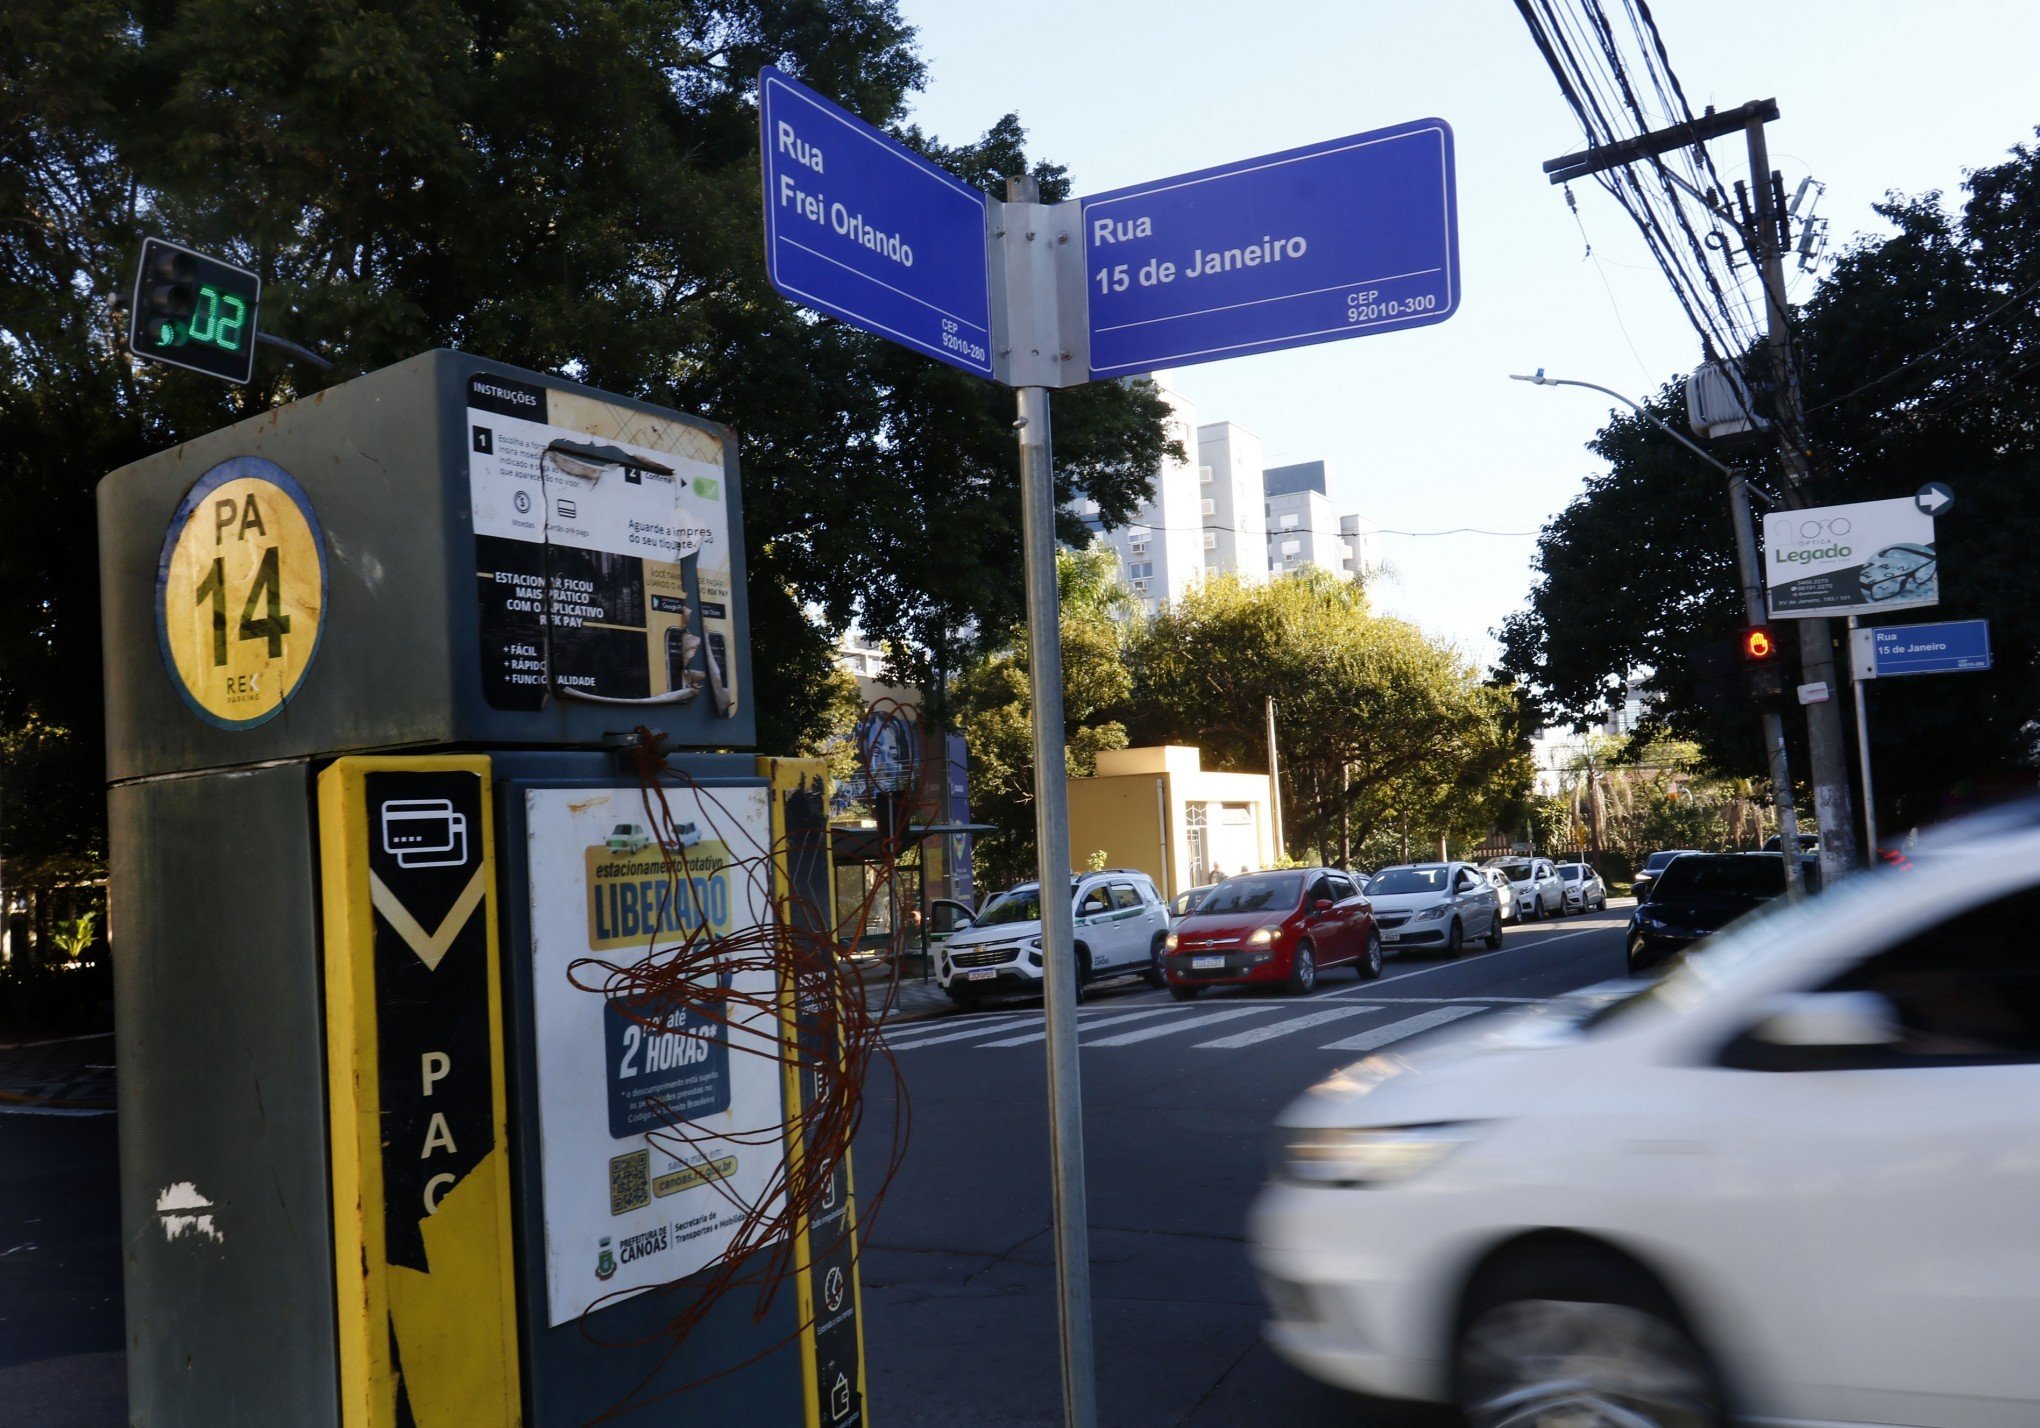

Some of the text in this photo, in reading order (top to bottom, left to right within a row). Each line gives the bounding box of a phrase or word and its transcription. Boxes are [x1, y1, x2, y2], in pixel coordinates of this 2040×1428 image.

[778, 119, 824, 174] Rua
[780, 174, 914, 268] Frei Orlando
[1094, 216, 1152, 247] Rua
[1096, 235, 1307, 294] 15 de Janeiro
[1347, 290, 1379, 307] CEP
[1348, 294, 1436, 323] 92010-300
[189, 287, 246, 350] 02
[942, 318, 958, 333] CEP
[942, 332, 985, 362] 92010-280
[473, 381, 537, 406] INSTRUÇÕES
[479, 434, 486, 447] 1
[498, 434, 524, 447] Escolha
[531, 440, 548, 450] form
[500, 468, 513, 477] que
[515, 470, 554, 483] apareceão
[555, 477, 563, 485] no
[215, 492, 266, 546] PA
[512, 519, 535, 529] Moedas
[628, 519, 664, 534] Aguarde
[666, 528, 671, 536] a
[629, 533, 639, 544] do
[642, 536, 657, 546] seu
[1775, 543, 1852, 565] Legado
[516, 587, 542, 599] MAIS
[564, 578, 593, 592] FICOU
[196, 546, 291, 667] 14
[506, 599, 531, 612] COM
[533, 602, 541, 613] O
[563, 616, 583, 628] PAY
[1876, 633, 1898, 641] Rua
[510, 643, 537, 656] FÁCIL
[1878, 642, 1947, 654] 15 de Janeiro
[227, 673, 259, 695] REK
[596, 855, 723, 878] estacionamento rotativo
[594, 875, 727, 940] LIBERADO
[667, 1007, 687, 1028] até
[619, 1025, 642, 1079] 2
[632, 1079, 684, 1098] descumprimento
[628, 1111, 651, 1123] Código
[675, 1211, 717, 1232] Secretaria de
[620, 1226, 667, 1249] PREFEITURA DE
[675, 1225, 713, 1243] Transportes
[620, 1235, 668, 1264] CANOAS
